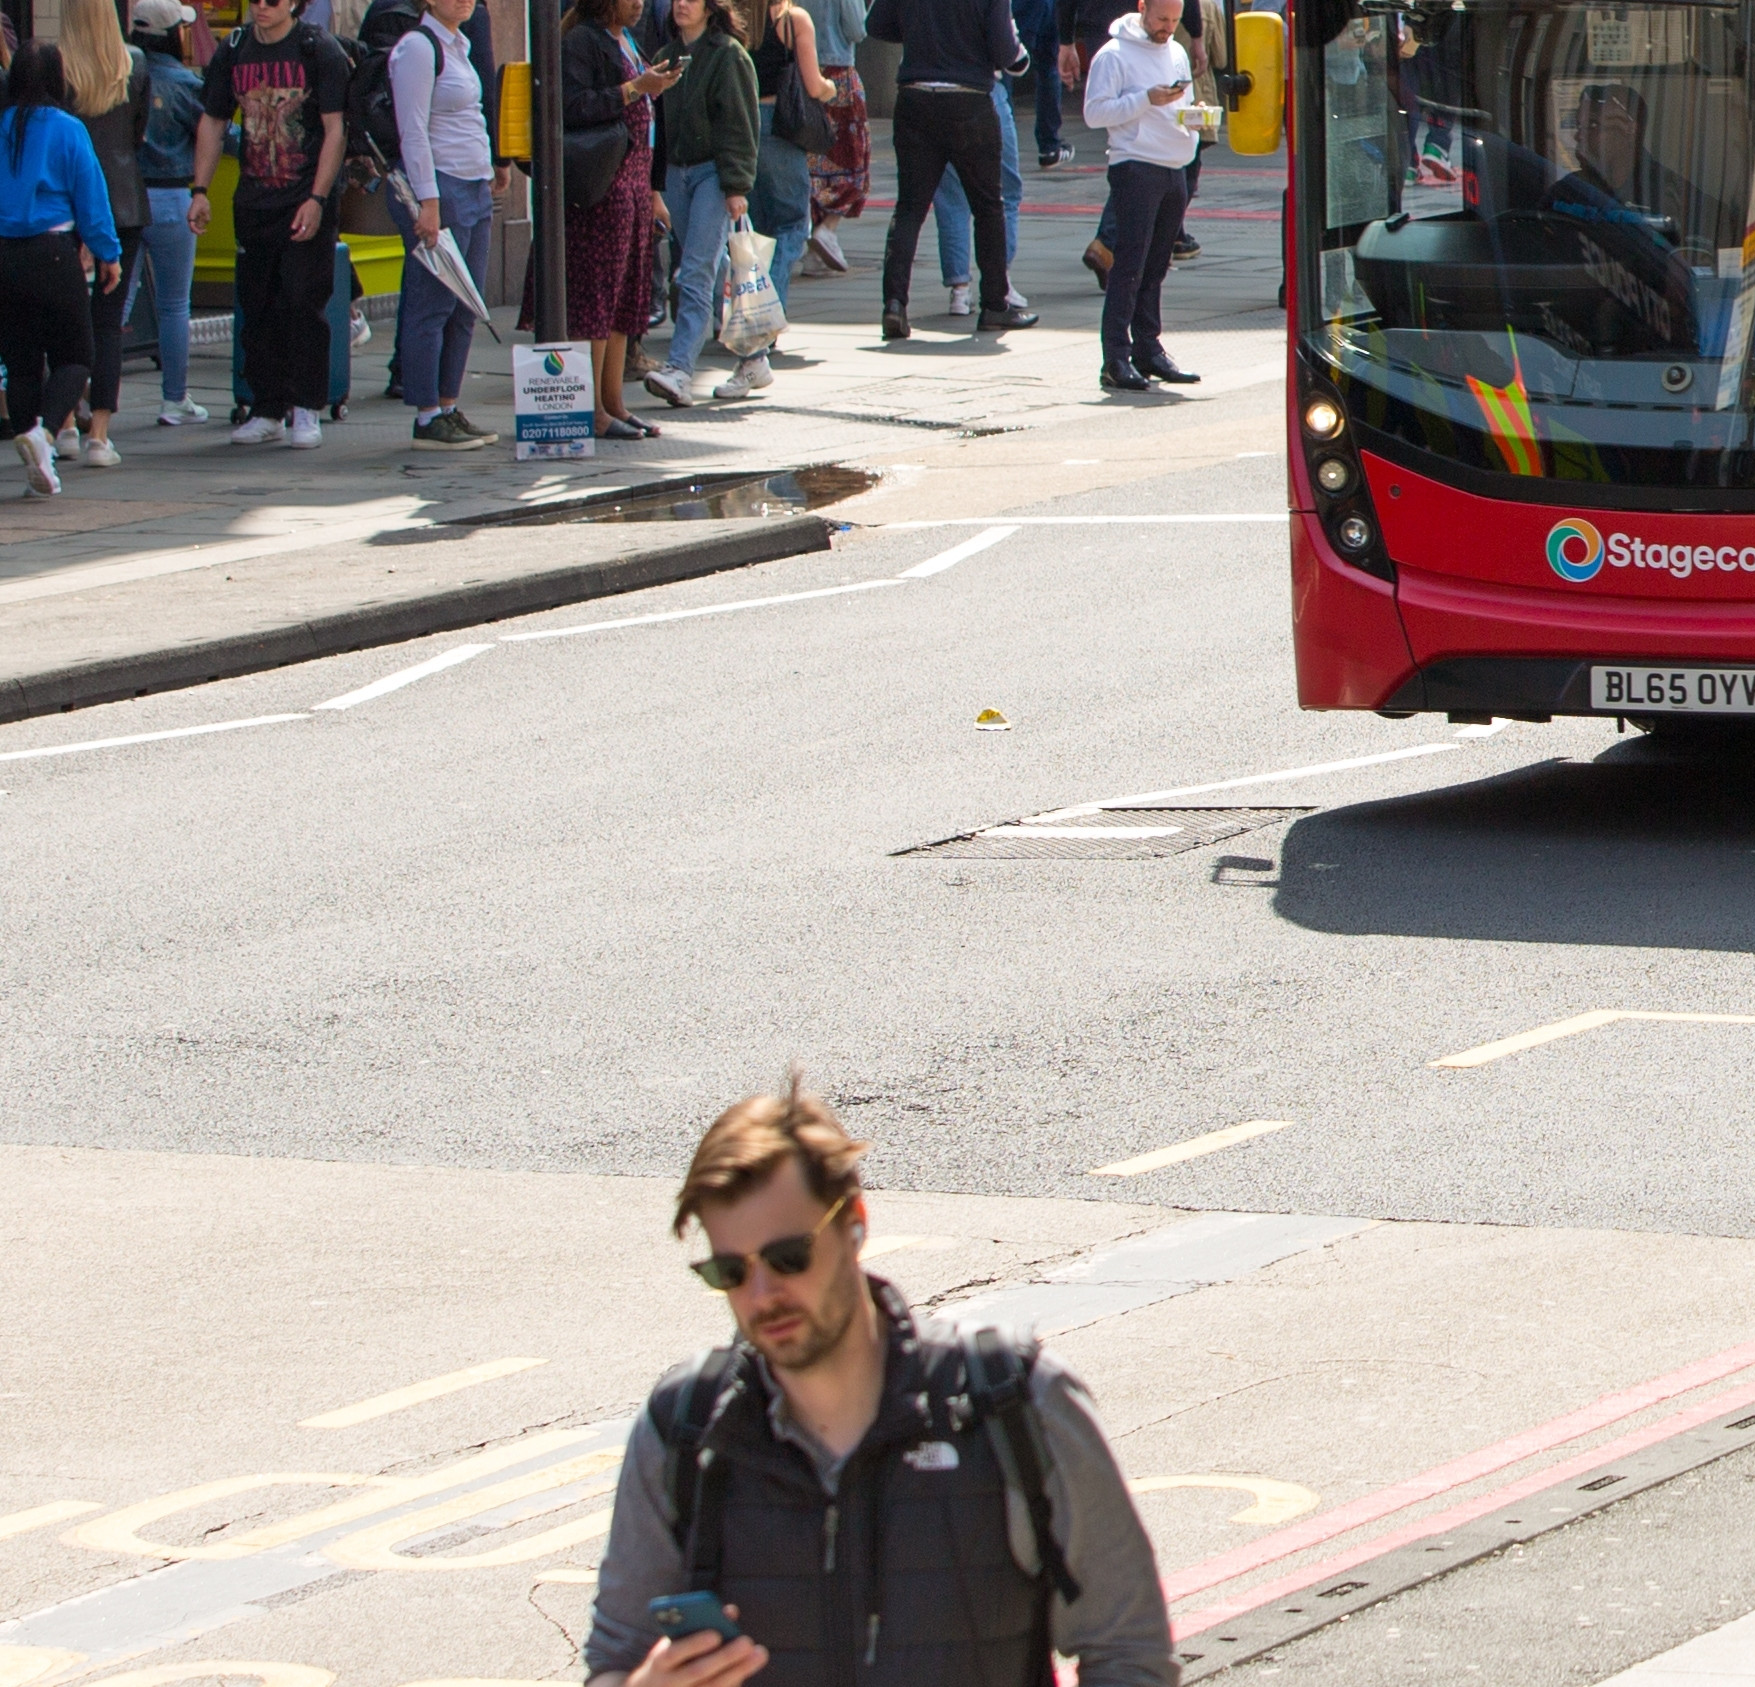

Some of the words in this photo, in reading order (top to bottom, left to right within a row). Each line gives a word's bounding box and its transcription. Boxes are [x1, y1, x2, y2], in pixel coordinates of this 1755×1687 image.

[232, 62, 306, 95] NIRVANA
[528, 376, 580, 385] RENEWABLE
[522, 384, 586, 395] UNDERFLOOR
[534, 393, 576, 403] HEATING
[537, 402, 574, 411] LONDON
[522, 425, 590, 439] 02071180800
[1604, 670, 1688, 704] BL65
